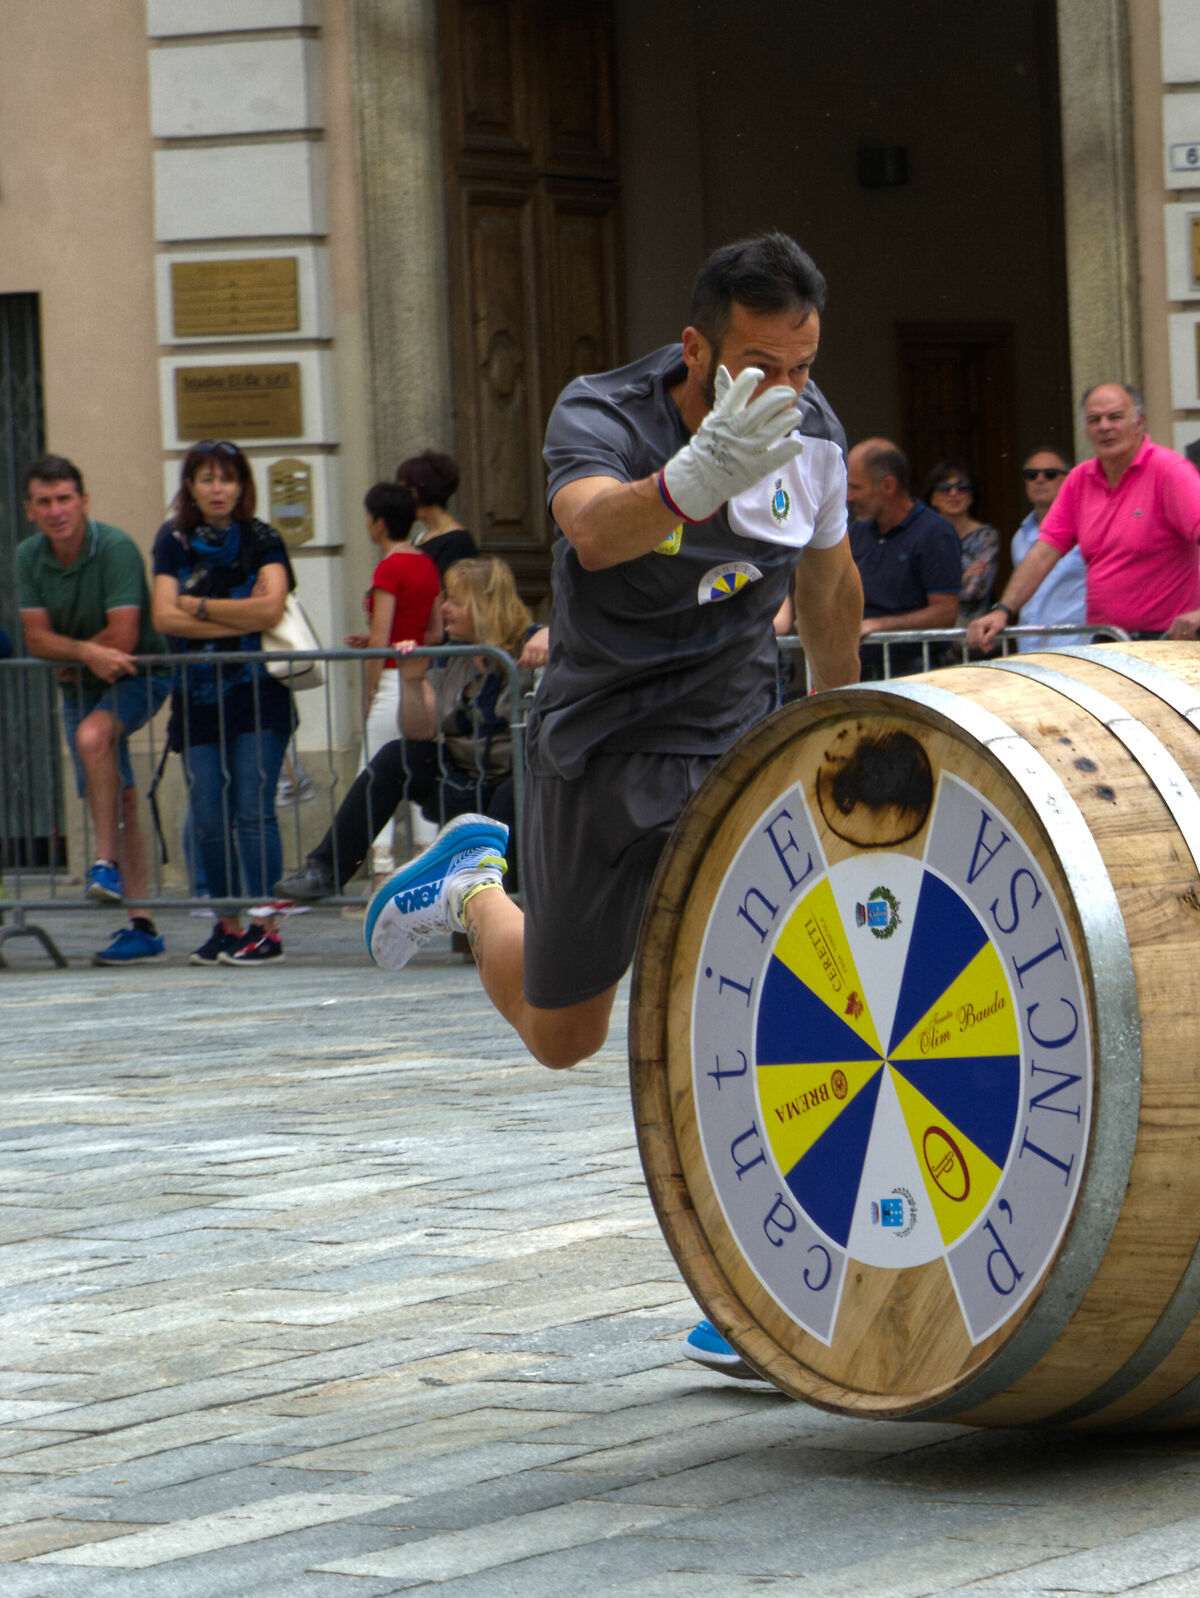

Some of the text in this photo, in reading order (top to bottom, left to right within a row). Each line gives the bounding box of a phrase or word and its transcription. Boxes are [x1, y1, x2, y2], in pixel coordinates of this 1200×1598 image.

[1185, 147, 1199, 166] 6
[393, 880, 444, 915] HOKA
[803, 918, 842, 992] CERETTI
[918, 990, 1006, 1055] Olim Bauda
[774, 1083, 830, 1124] BREMA
